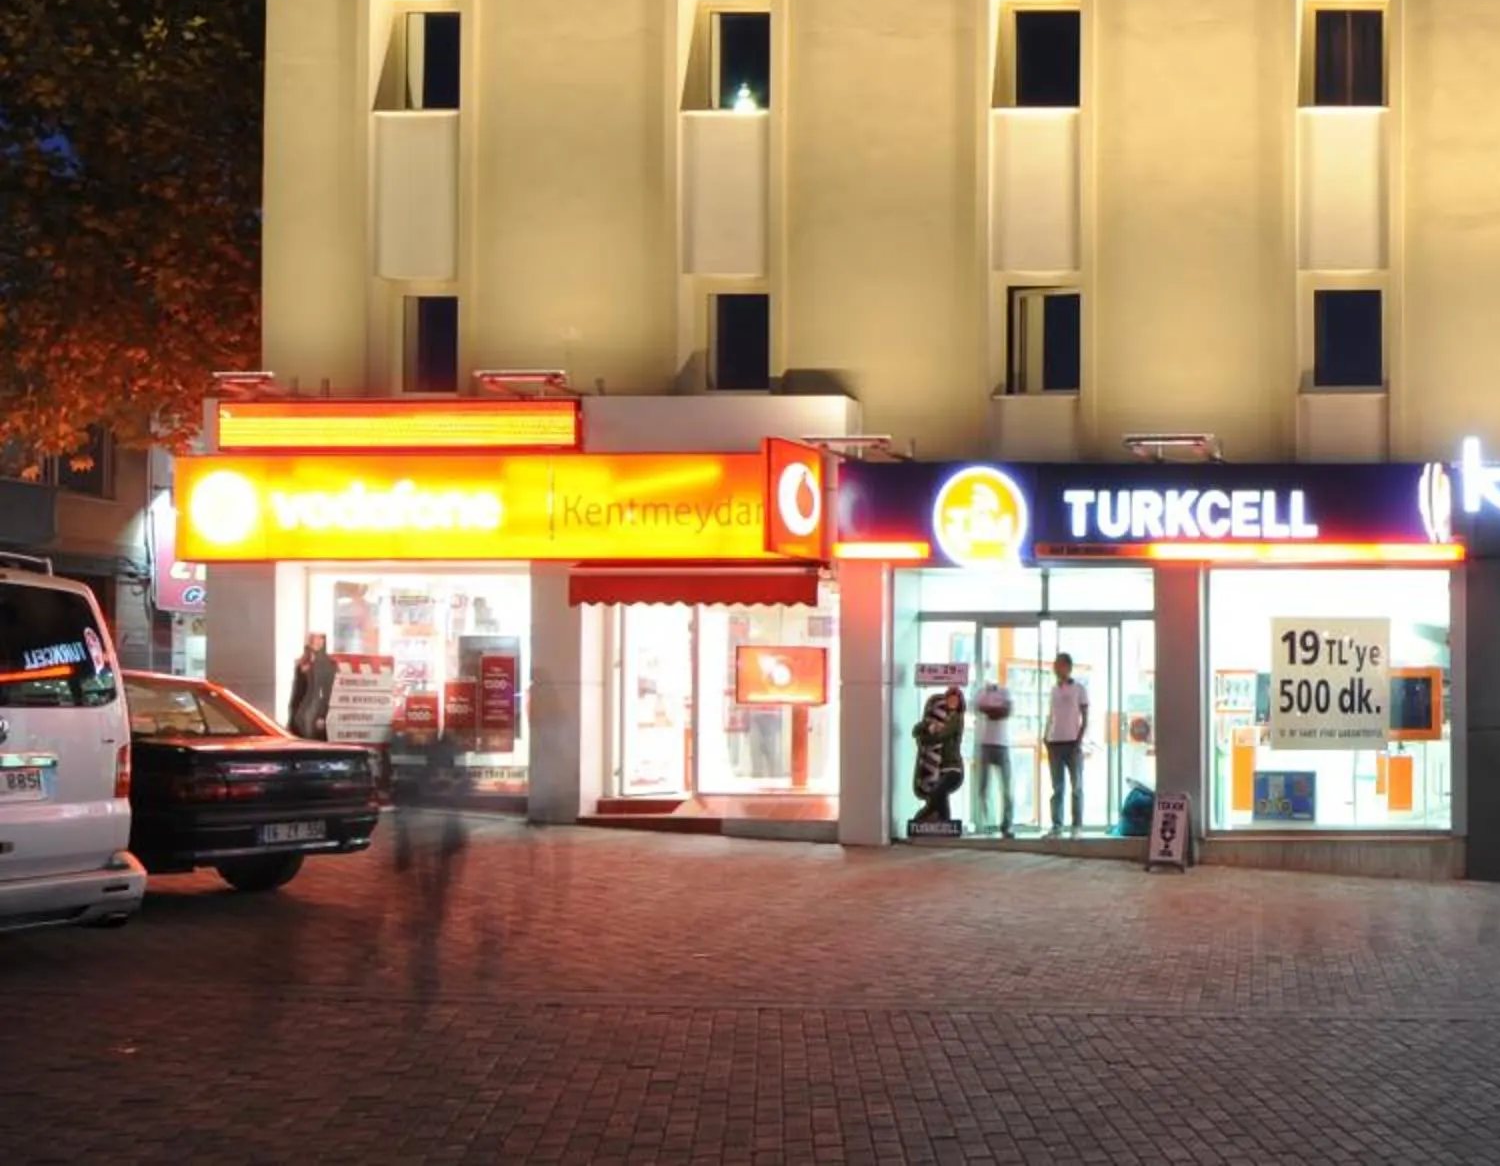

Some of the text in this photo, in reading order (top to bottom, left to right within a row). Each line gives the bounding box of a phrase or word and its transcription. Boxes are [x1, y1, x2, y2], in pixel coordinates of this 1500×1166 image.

[270, 480, 503, 530] vodafone
[1064, 490, 1318, 539] TURKCELL
[1280, 630, 1381, 673] 19 TL'ye
[1279, 677, 1381, 714] 500 dk.
